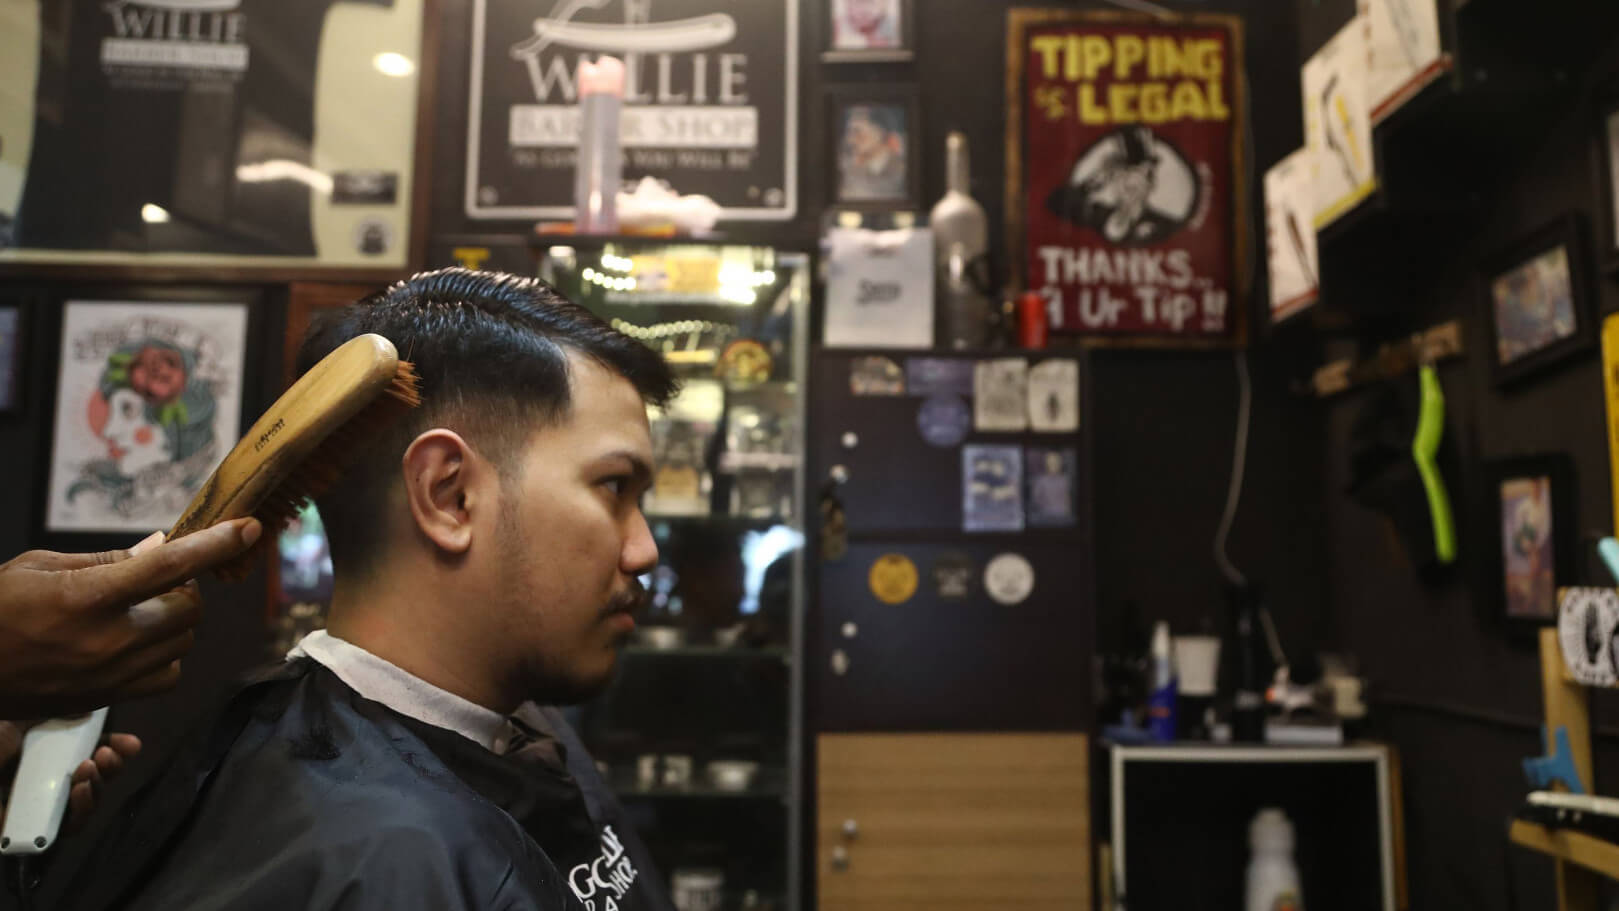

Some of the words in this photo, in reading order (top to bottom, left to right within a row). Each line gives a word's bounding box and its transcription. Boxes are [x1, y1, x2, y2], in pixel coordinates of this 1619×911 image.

[106, 10, 244, 43] WILLIE
[522, 52, 749, 104] WLLIE
[1031, 34, 1223, 82] TIPPING
[1077, 81, 1230, 126] LEGAL
[659, 112, 753, 143] SHOP
[1078, 286, 1128, 329] Ur
[1134, 286, 1197, 333] Tip
